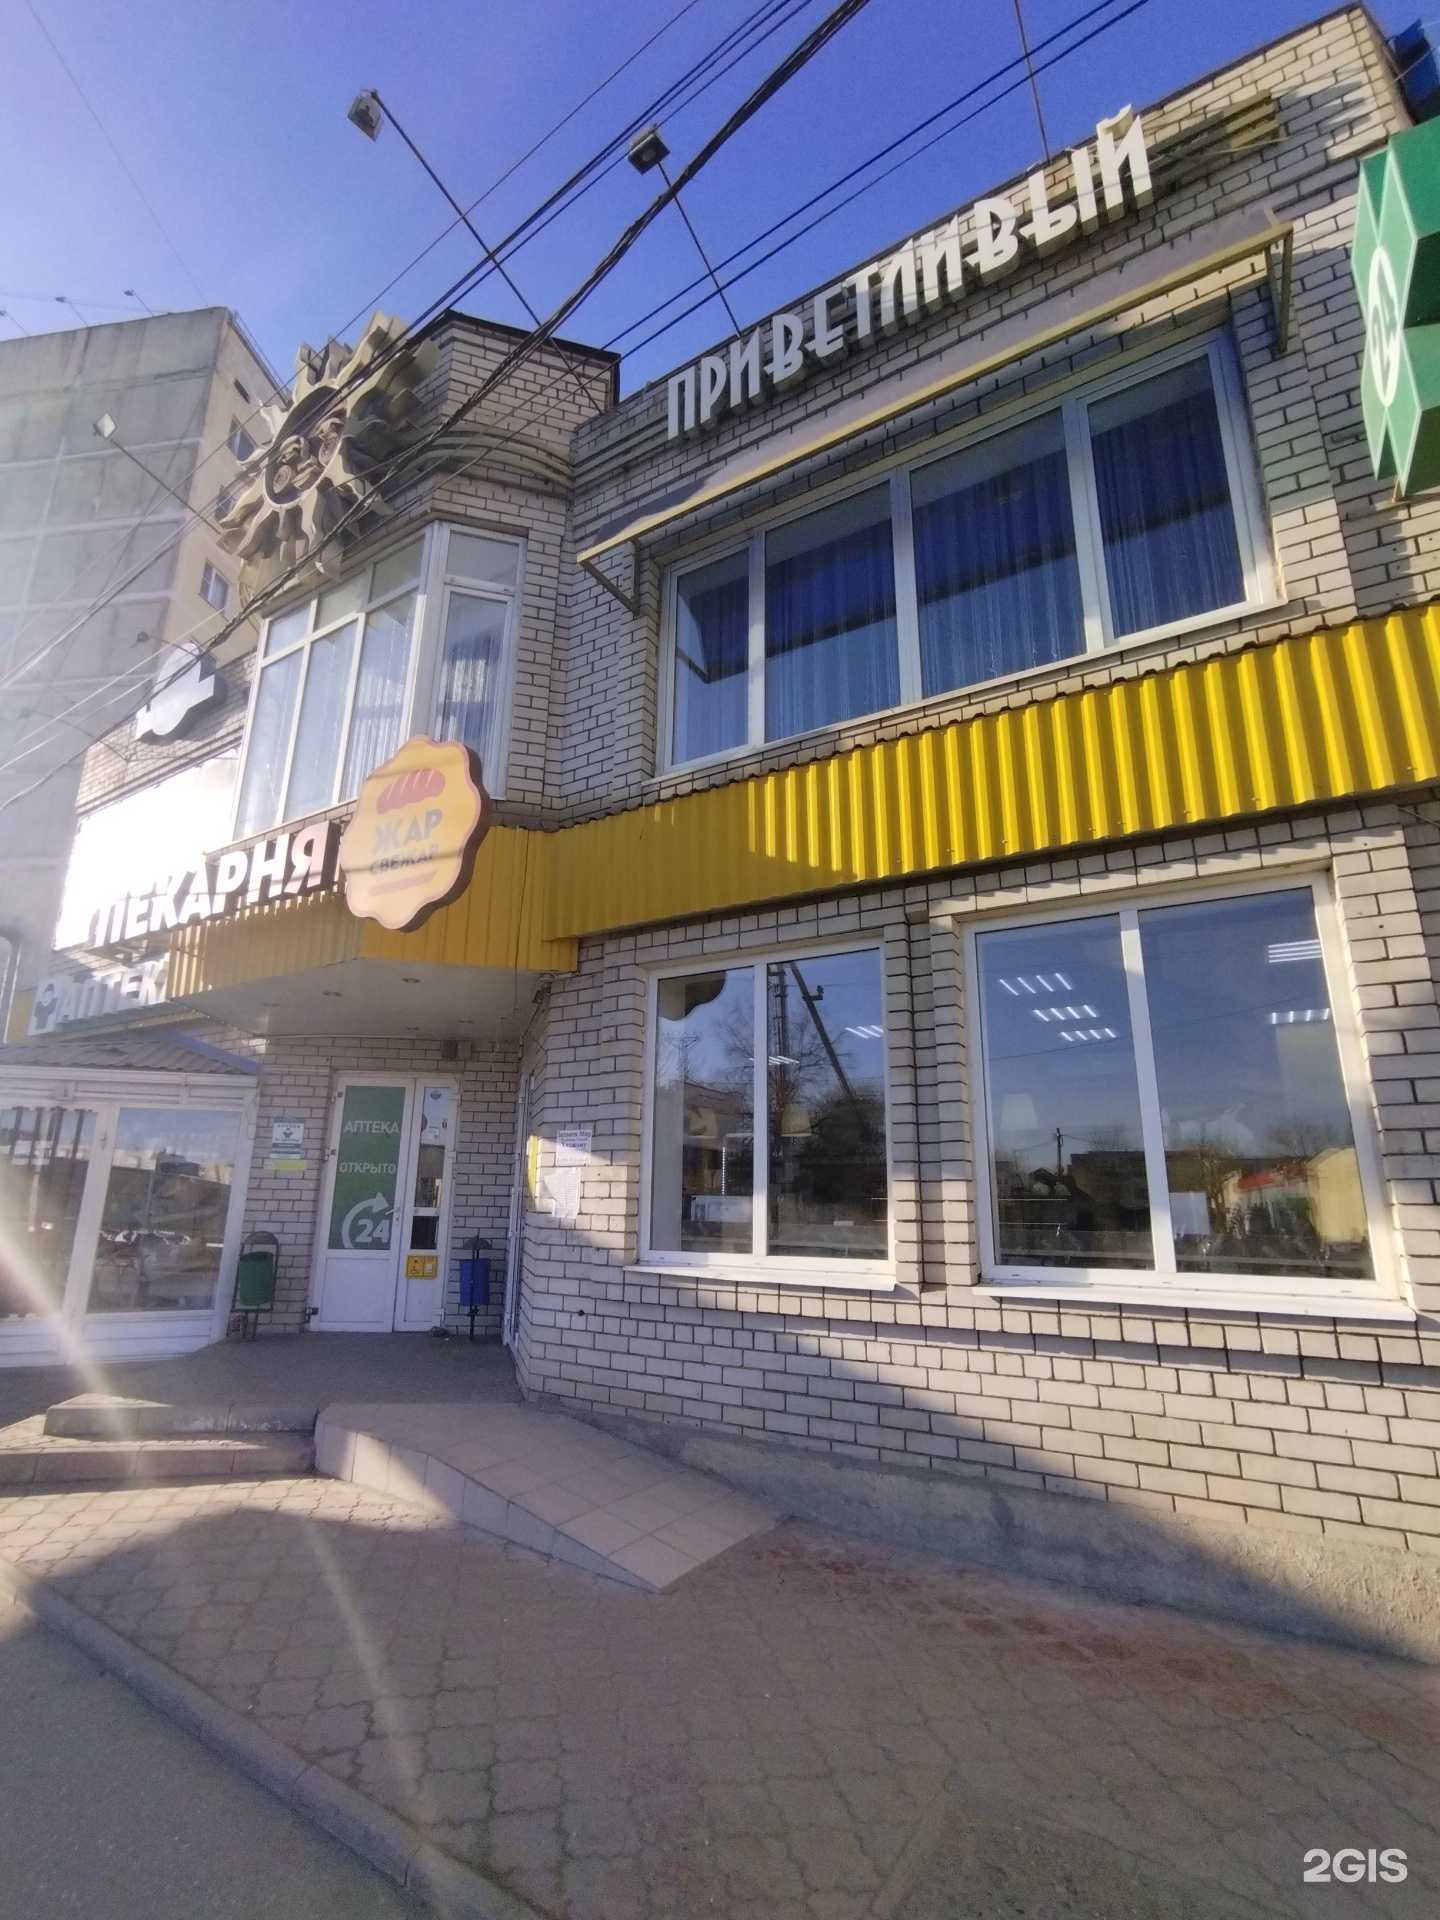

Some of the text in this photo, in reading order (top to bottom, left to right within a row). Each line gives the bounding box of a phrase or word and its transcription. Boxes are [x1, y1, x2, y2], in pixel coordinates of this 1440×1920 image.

[666, 104, 1153, 441] ПРИВЕТЛИВЫЙ
[373, 808, 443, 853] ЖАР
[92, 821, 332, 948] ПЕКАРНЯ
[55, 956, 168, 1023] АПТЕК
[343, 1120, 400, 1135] АПТЕКА
[339, 1161, 397, 1175] ОТКРЫТО
[355, 1218, 391, 1244] 24
